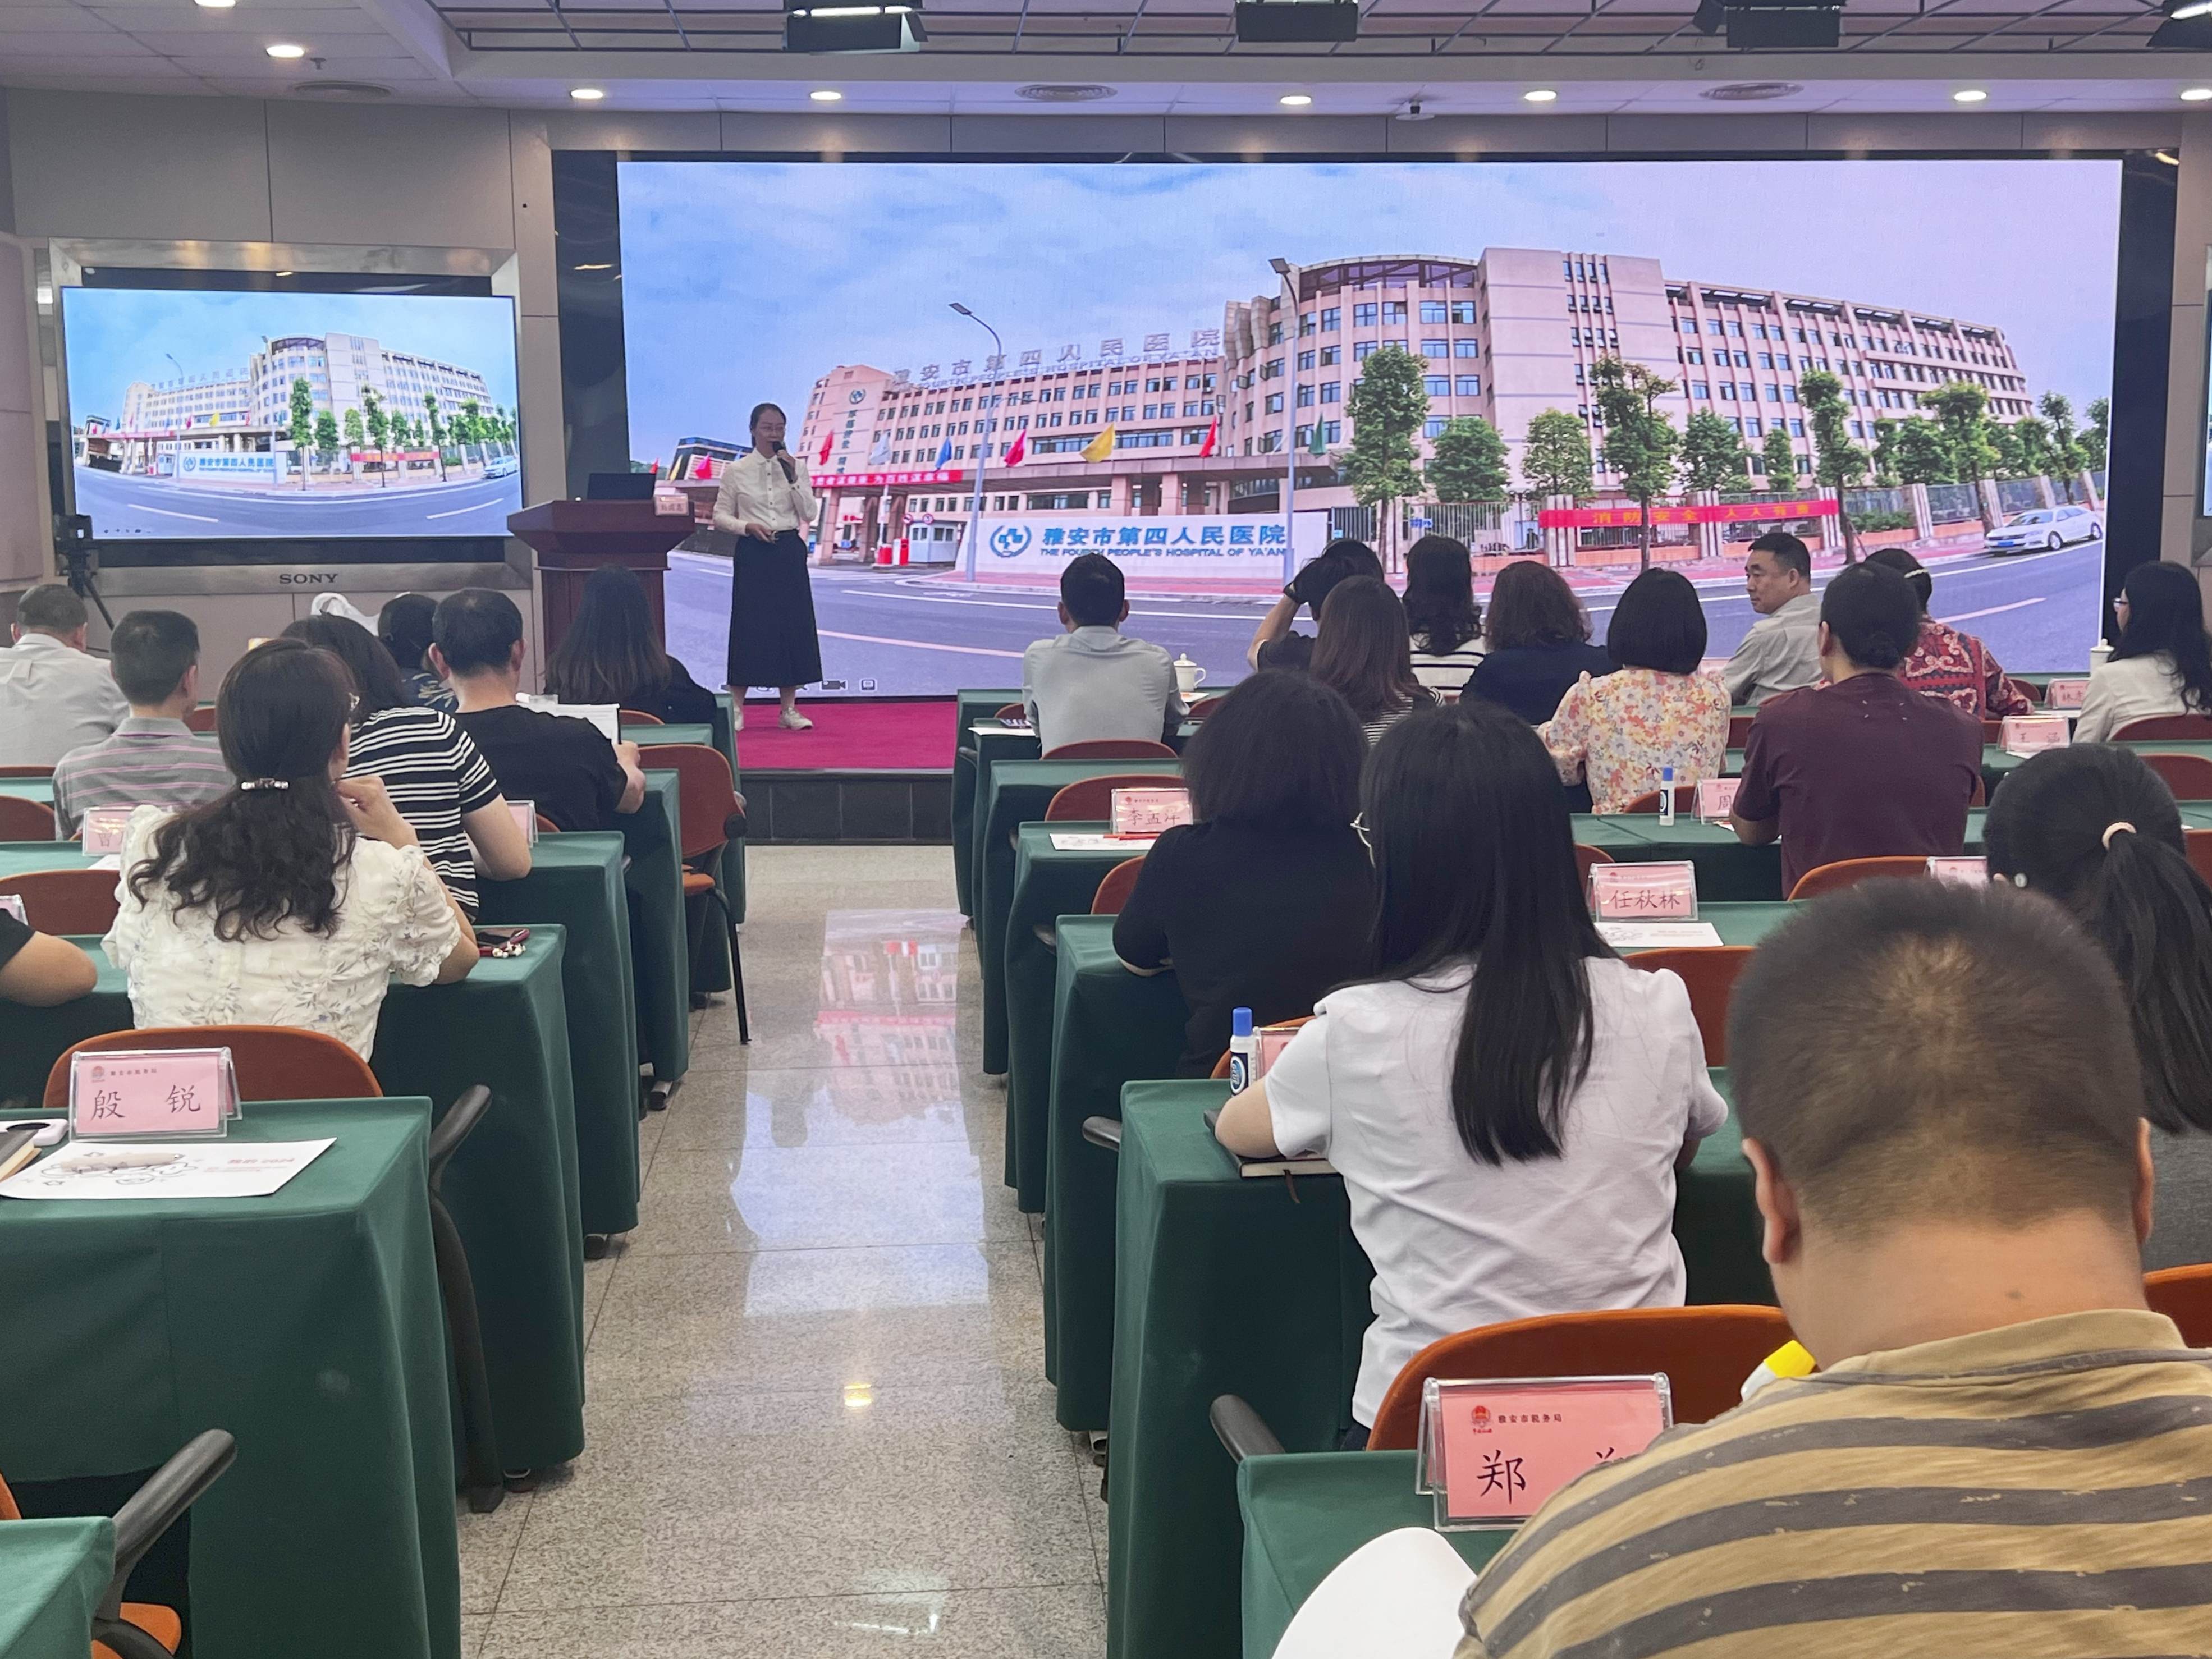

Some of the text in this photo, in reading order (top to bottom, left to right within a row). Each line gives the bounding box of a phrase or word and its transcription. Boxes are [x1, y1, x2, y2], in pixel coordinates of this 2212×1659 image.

[1593, 509, 1697, 524] 消防安全
[1042, 524, 1286, 546] 雅安市第四人民医院
[1107, 548, 1162, 556] PEOPLE'S
[1166, 548, 1224, 557] HOSPITAL
[1227, 548, 1244, 556] OF
[279, 574, 338, 584] SONY
[1717, 795, 1732, 811] 周
[1611, 889, 1681, 910] 任秋林
[90, 1084, 201, 1121] 殷锐
[1498, 1414, 1562, 1424] 雅安市税务局
